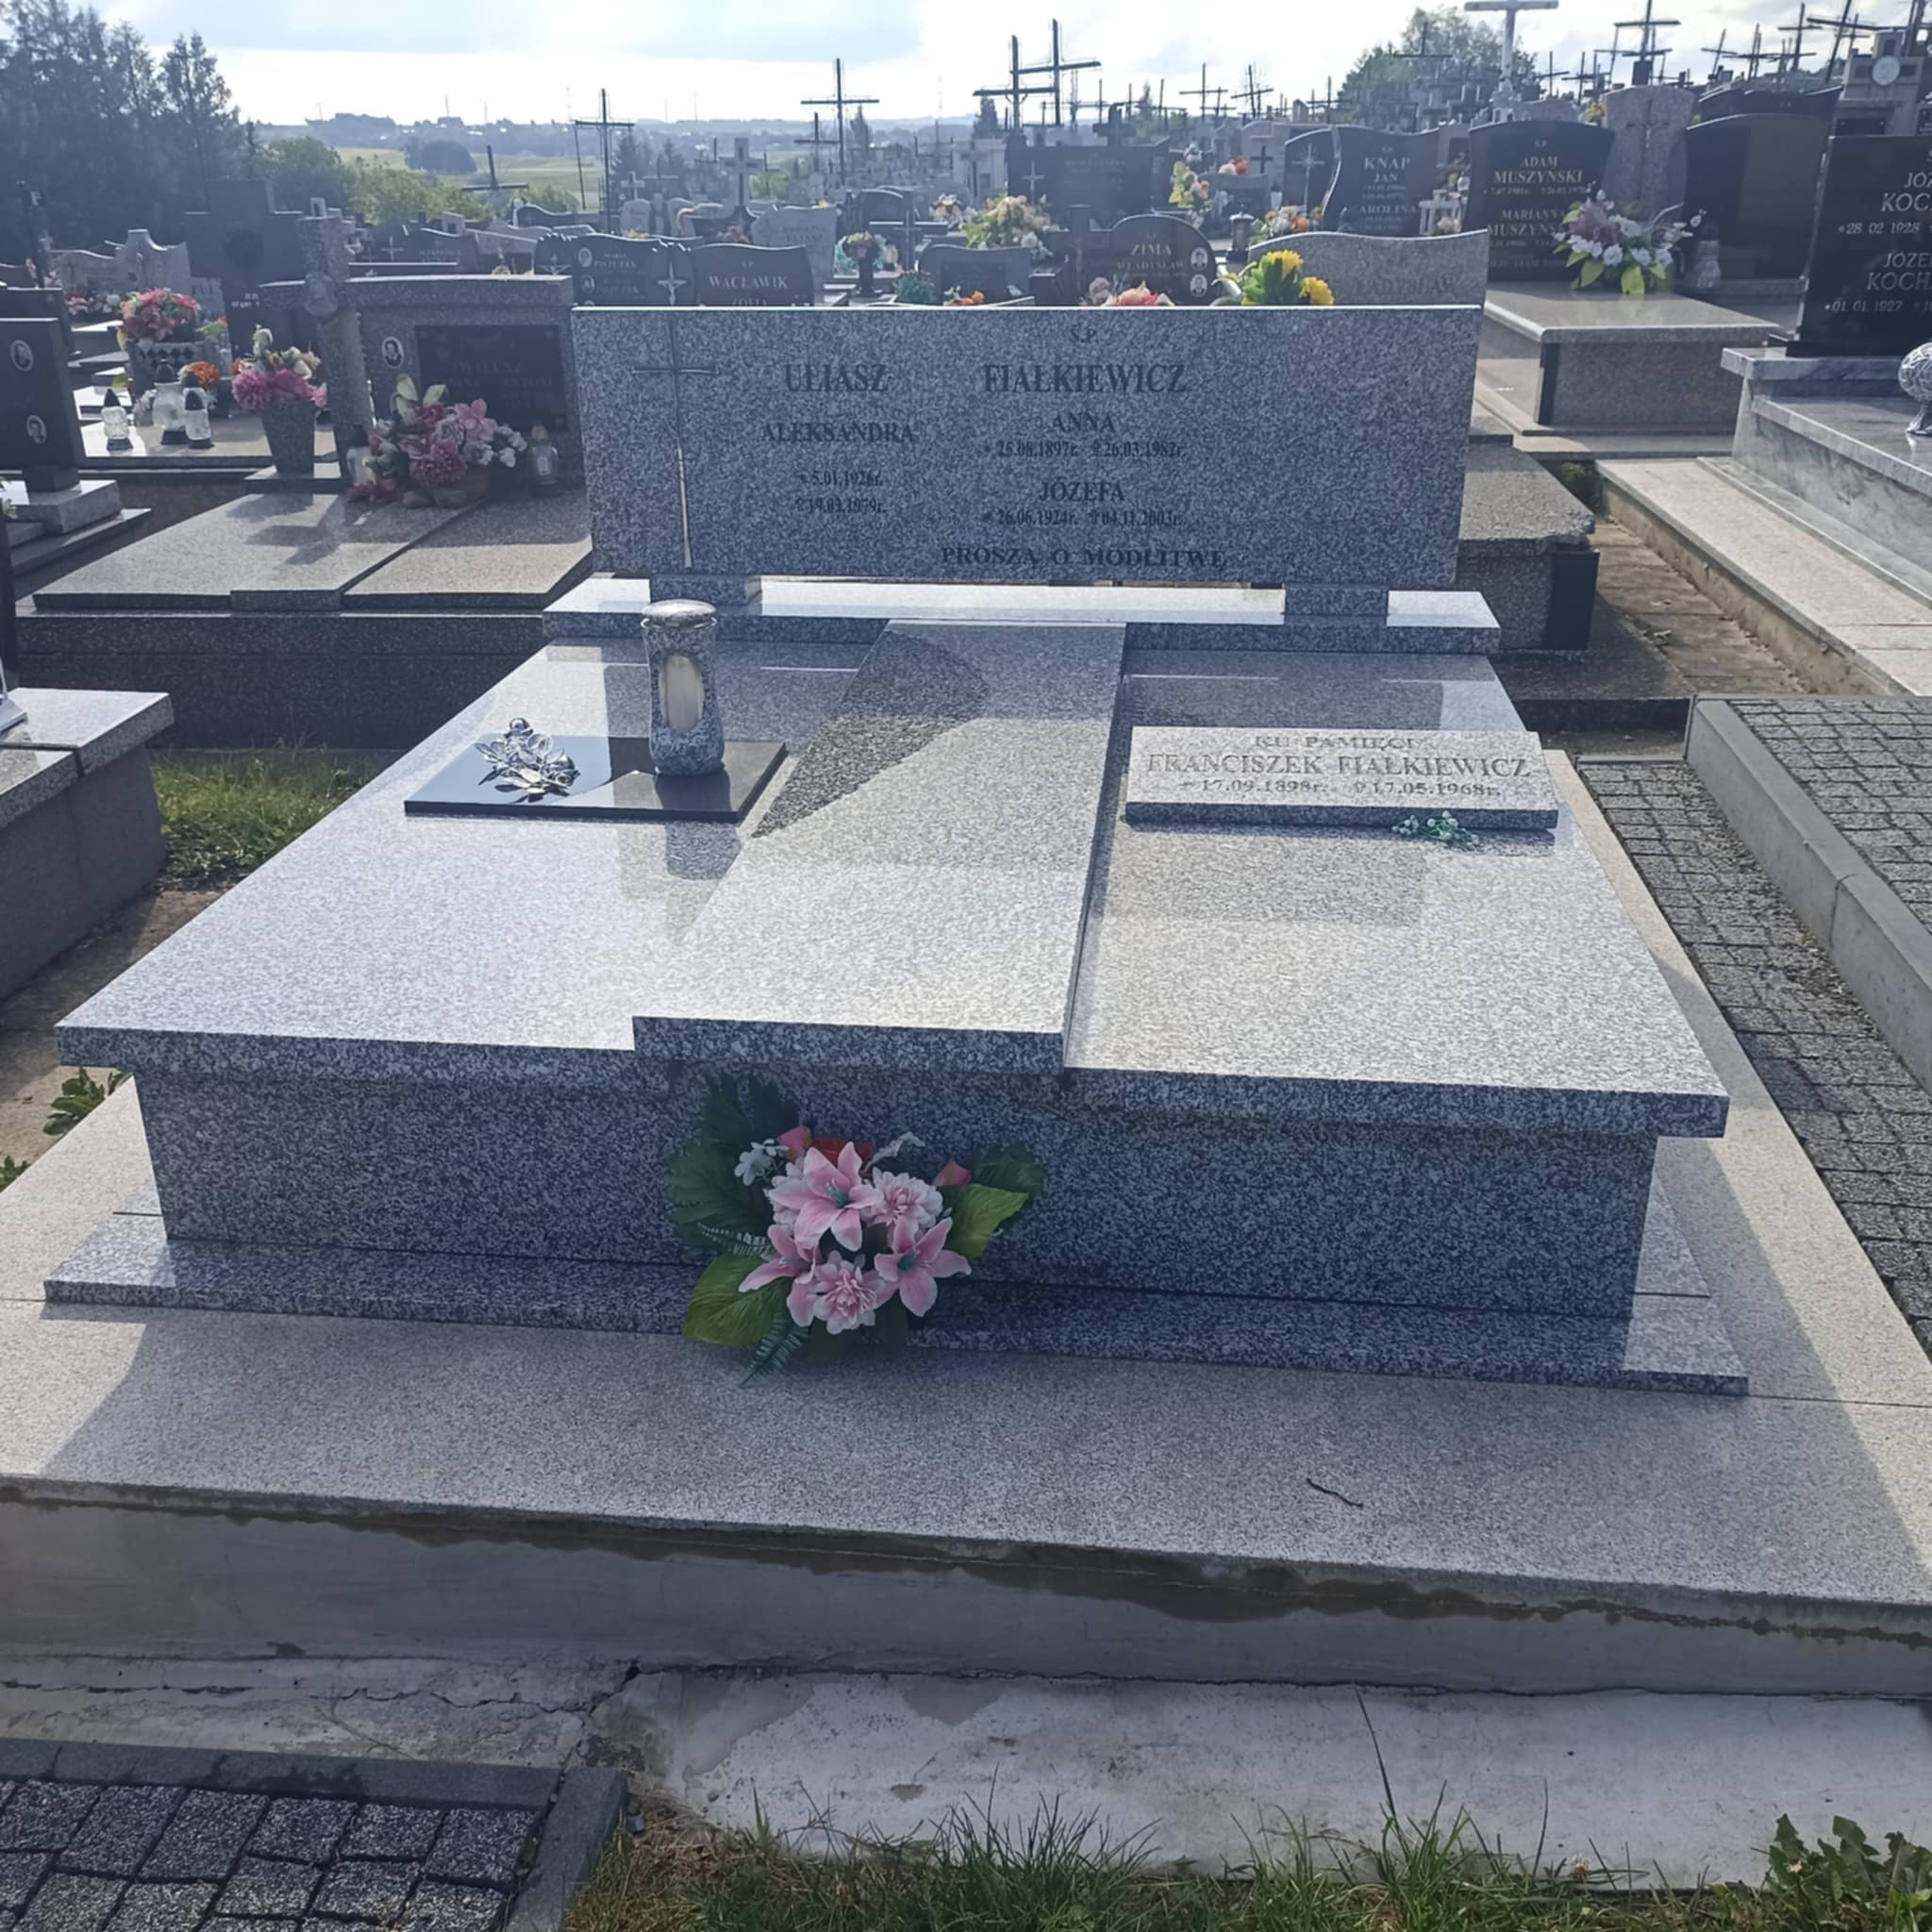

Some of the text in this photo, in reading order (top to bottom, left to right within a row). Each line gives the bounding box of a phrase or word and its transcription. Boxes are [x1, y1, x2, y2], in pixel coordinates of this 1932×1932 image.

[1364, 157, 1411, 170] KNAP
[1523, 156, 1558, 168] ADAM
[1374, 173, 1397, 183] JAN
[1881, 192, 1932, 212] KOC
[1131, 242, 1172, 257] ZIMA
[1883, 250, 1932, 268] JÓZE
[1867, 272, 1932, 291] KOCH
[762, 421, 919, 443] ALEKSANDRA
[1052, 411, 1116, 435] ANNA
[1051, 547, 1070, 566] O
[1147, 754, 1324, 774] FRANCISZEK
